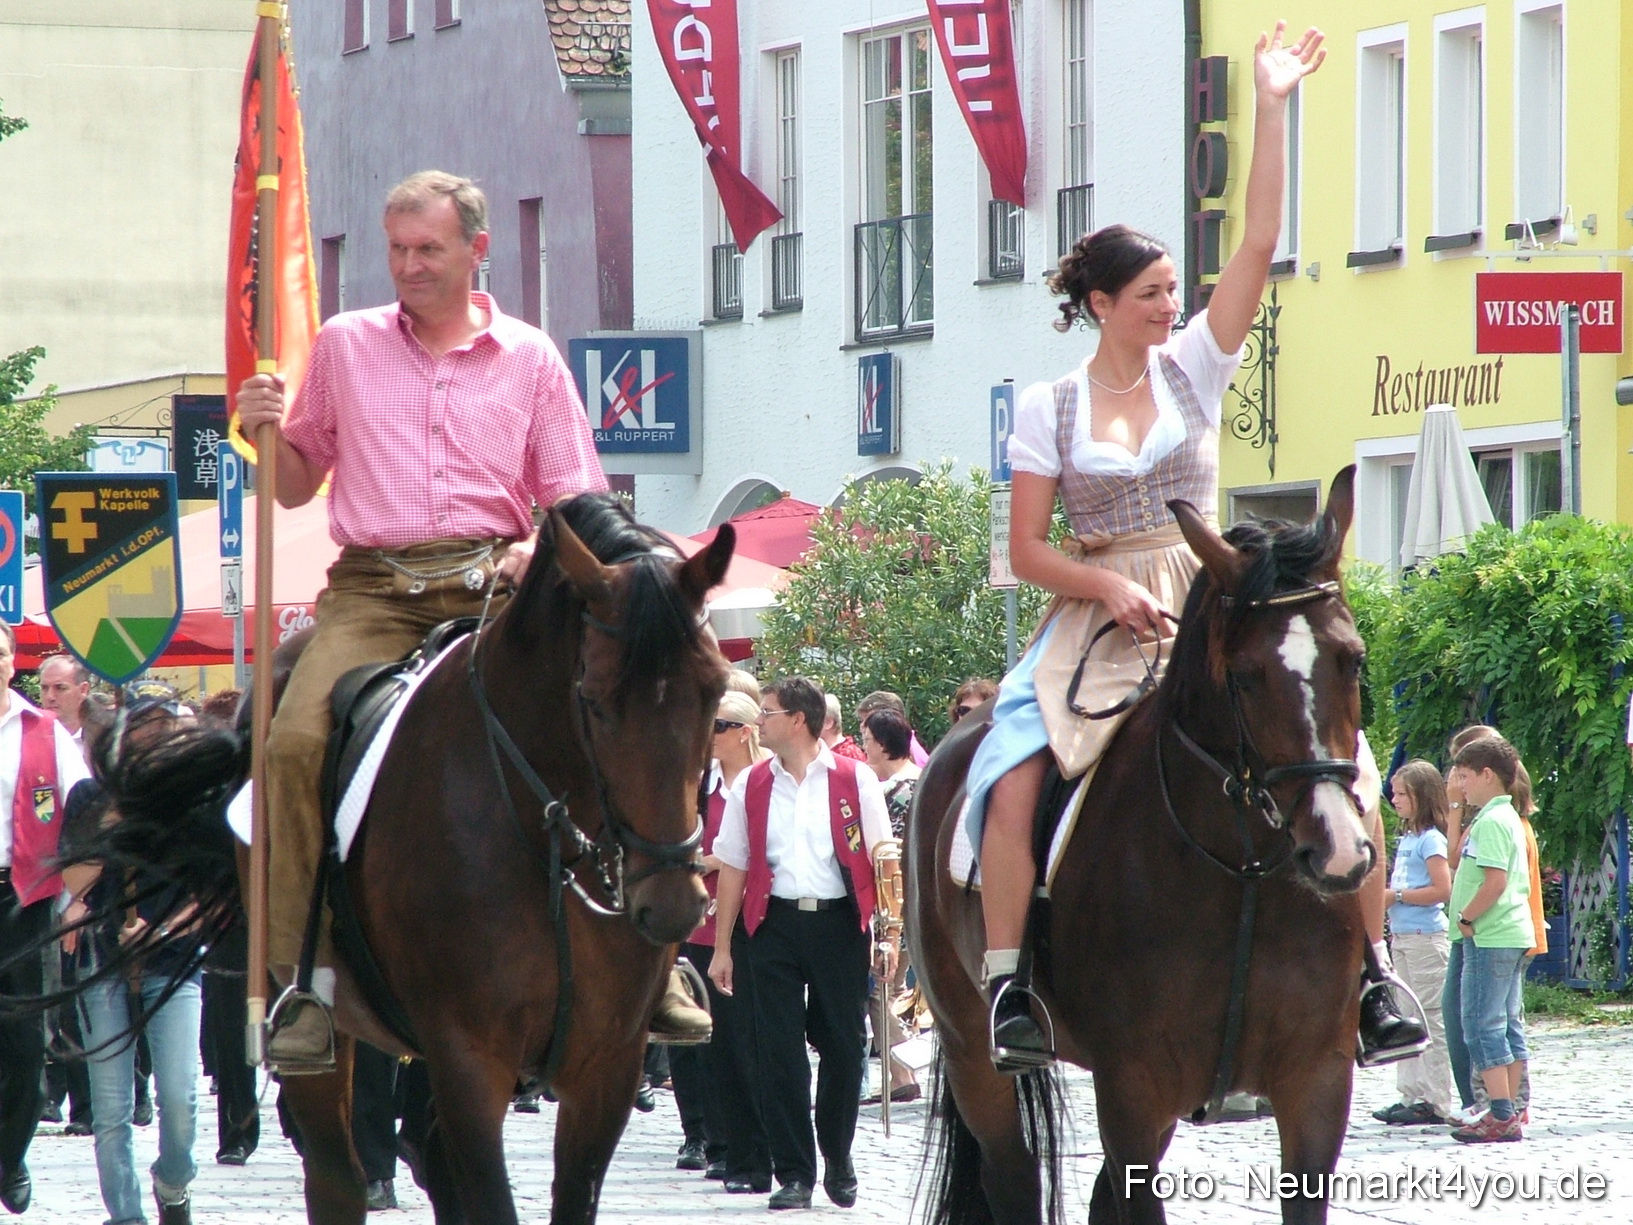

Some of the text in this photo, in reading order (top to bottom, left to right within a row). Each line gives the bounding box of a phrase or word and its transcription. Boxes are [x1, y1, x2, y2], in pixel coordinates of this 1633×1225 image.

[1484, 300, 1615, 326] WISSMCH
[1371, 355, 1503, 416] Restaurant
[594, 431, 675, 442] &L RUPPERT
[996, 398, 1009, 470] P
[99, 488, 161, 499] Werkvolk
[222, 453, 238, 519] P
[100, 500, 150, 512] Kapelle
[62, 554, 119, 593] Neumarkt
[278, 606, 315, 644] Glo
